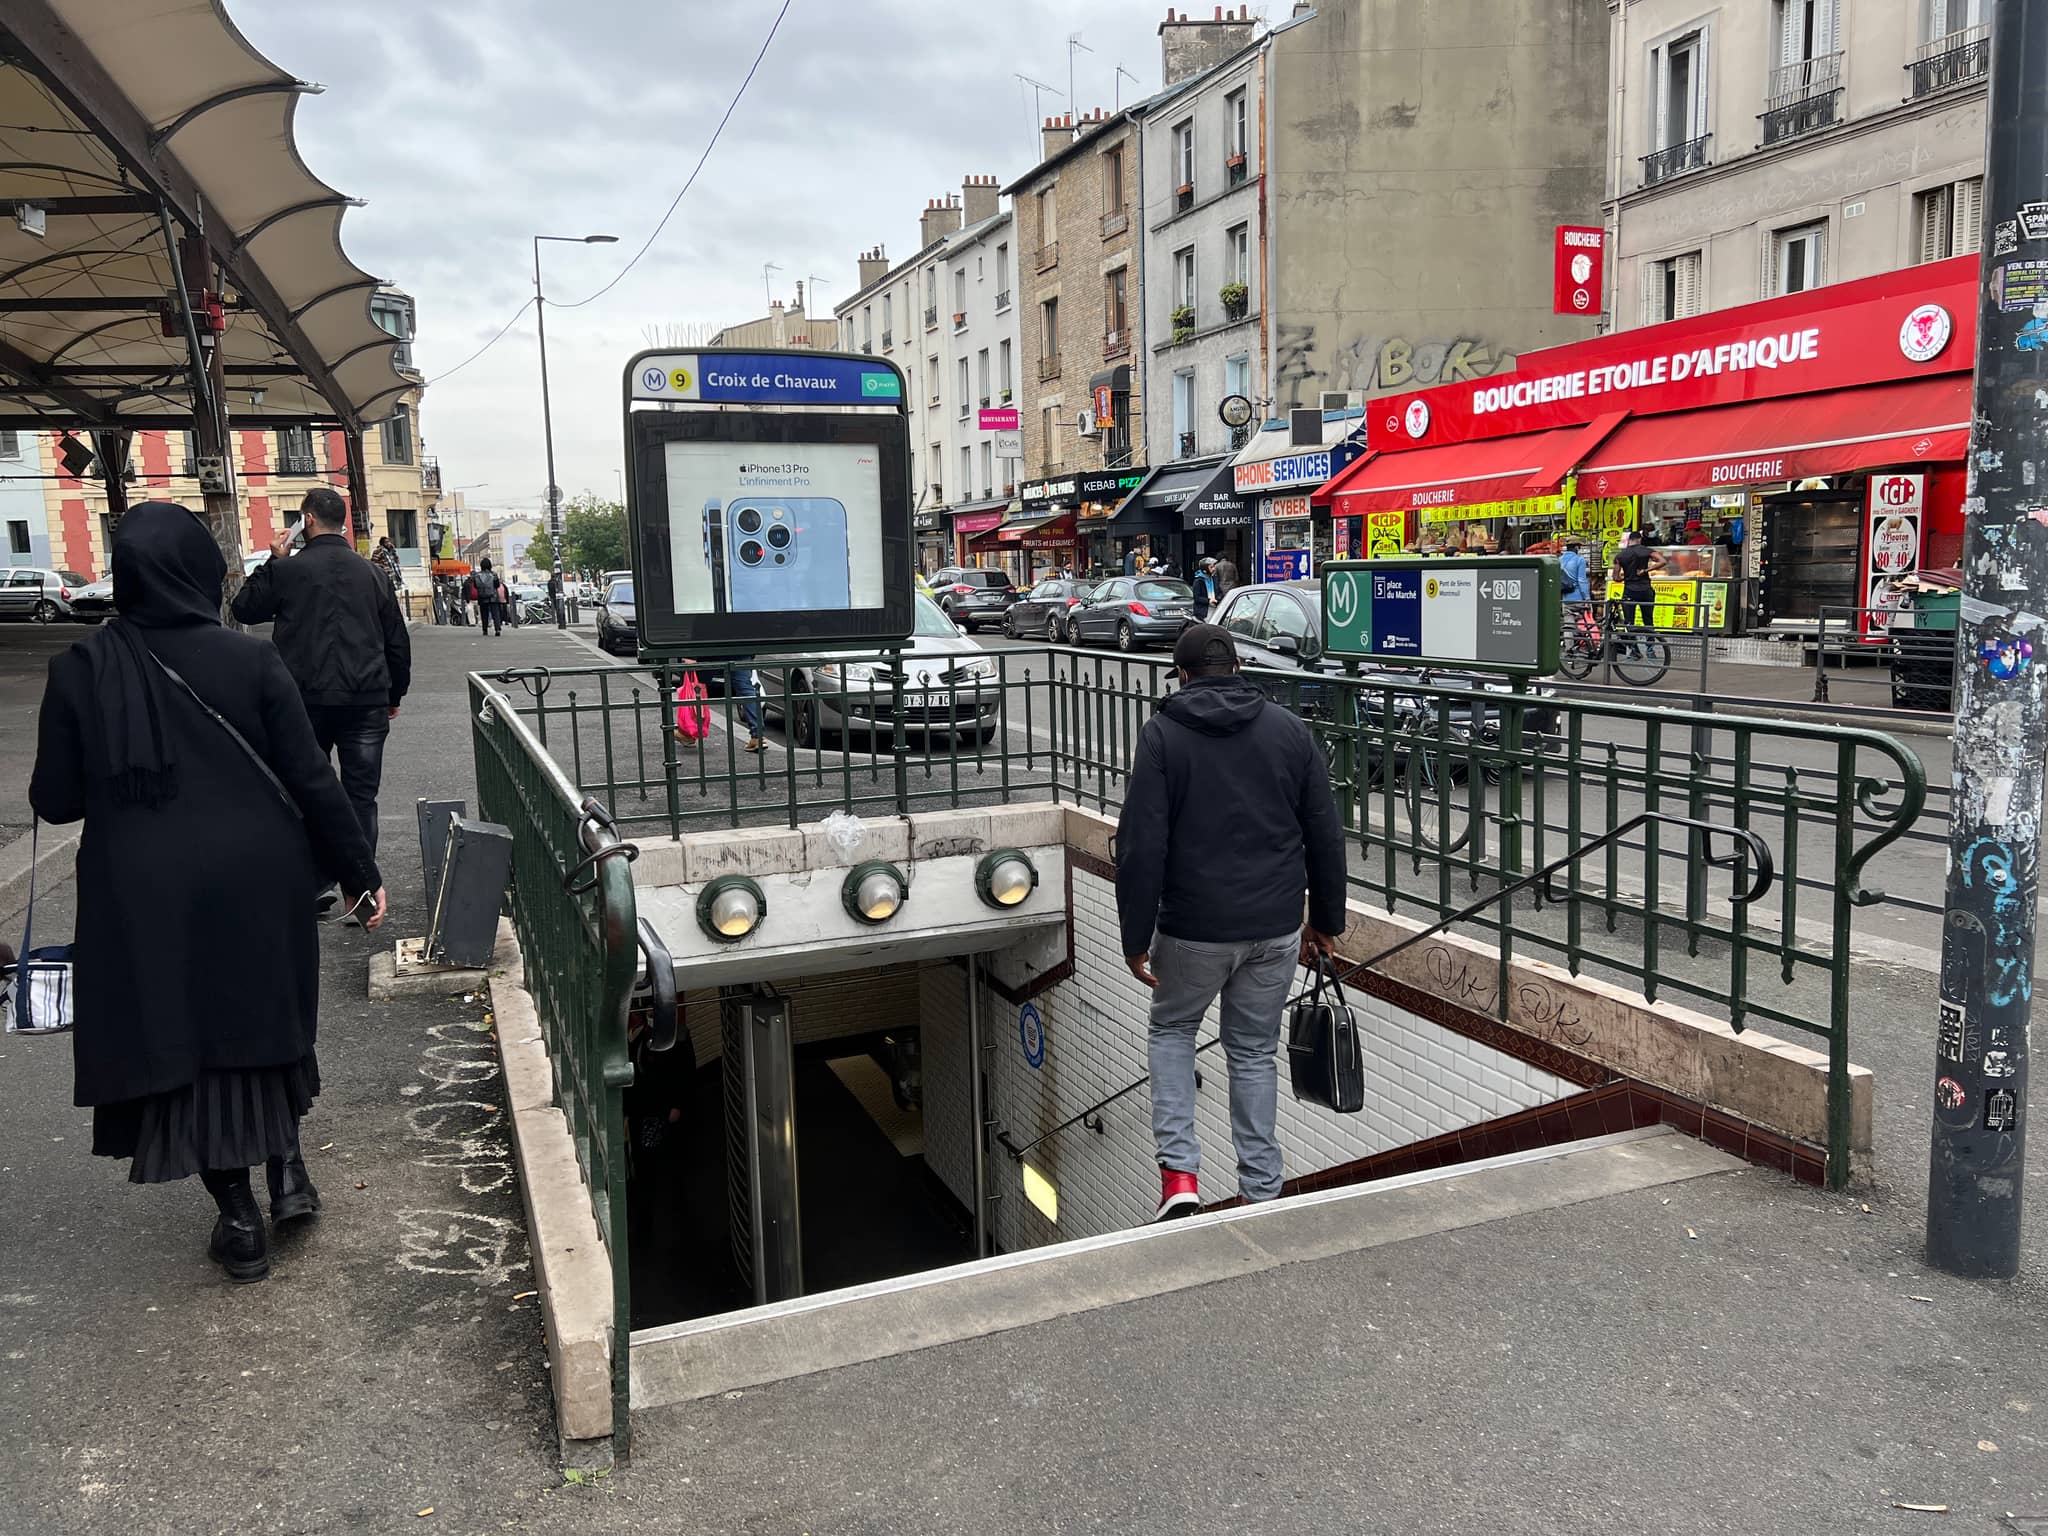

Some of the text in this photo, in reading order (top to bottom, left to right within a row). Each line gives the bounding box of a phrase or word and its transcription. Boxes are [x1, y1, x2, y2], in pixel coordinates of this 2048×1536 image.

[1564, 231, 1600, 248] BOUCHERIE
[1473, 328, 1819, 414] BOUCHERIE ETOILE D'AFRIQUE
[675, 373, 686, 387] 9
[707, 372, 747, 387] Croix
[751, 372, 770, 388] de
[774, 373, 837, 390] Chavaux
[747, 464, 809, 473] iPhone 13 Pro
[1711, 459, 1783, 482] BOUCHERIE
[739, 477, 810, 487] L'infiniment Pro
[1083, 479, 1116, 492] KEBAB
[1213, 493, 1229, 501] BAR
[1412, 488, 1455, 506] BOUCHERIE
[1199, 501, 1245, 510] RESTAURANT
[1194, 516, 1252, 526] CAFE DE LA PLACE
[1582, 510, 1590, 530] 5
[1616, 508, 1625, 528] 8
[1049, 538, 1075, 547] LEGUMES
[1332, 581, 1350, 614] M
[1377, 584, 1383, 596] 5
[1386, 581, 1402, 591] place
[1429, 582, 1435, 595] 9
[1386, 590, 1395, 600] du
[1396, 590, 1417, 600] Marché
[1495, 613, 1500, 623] 2
